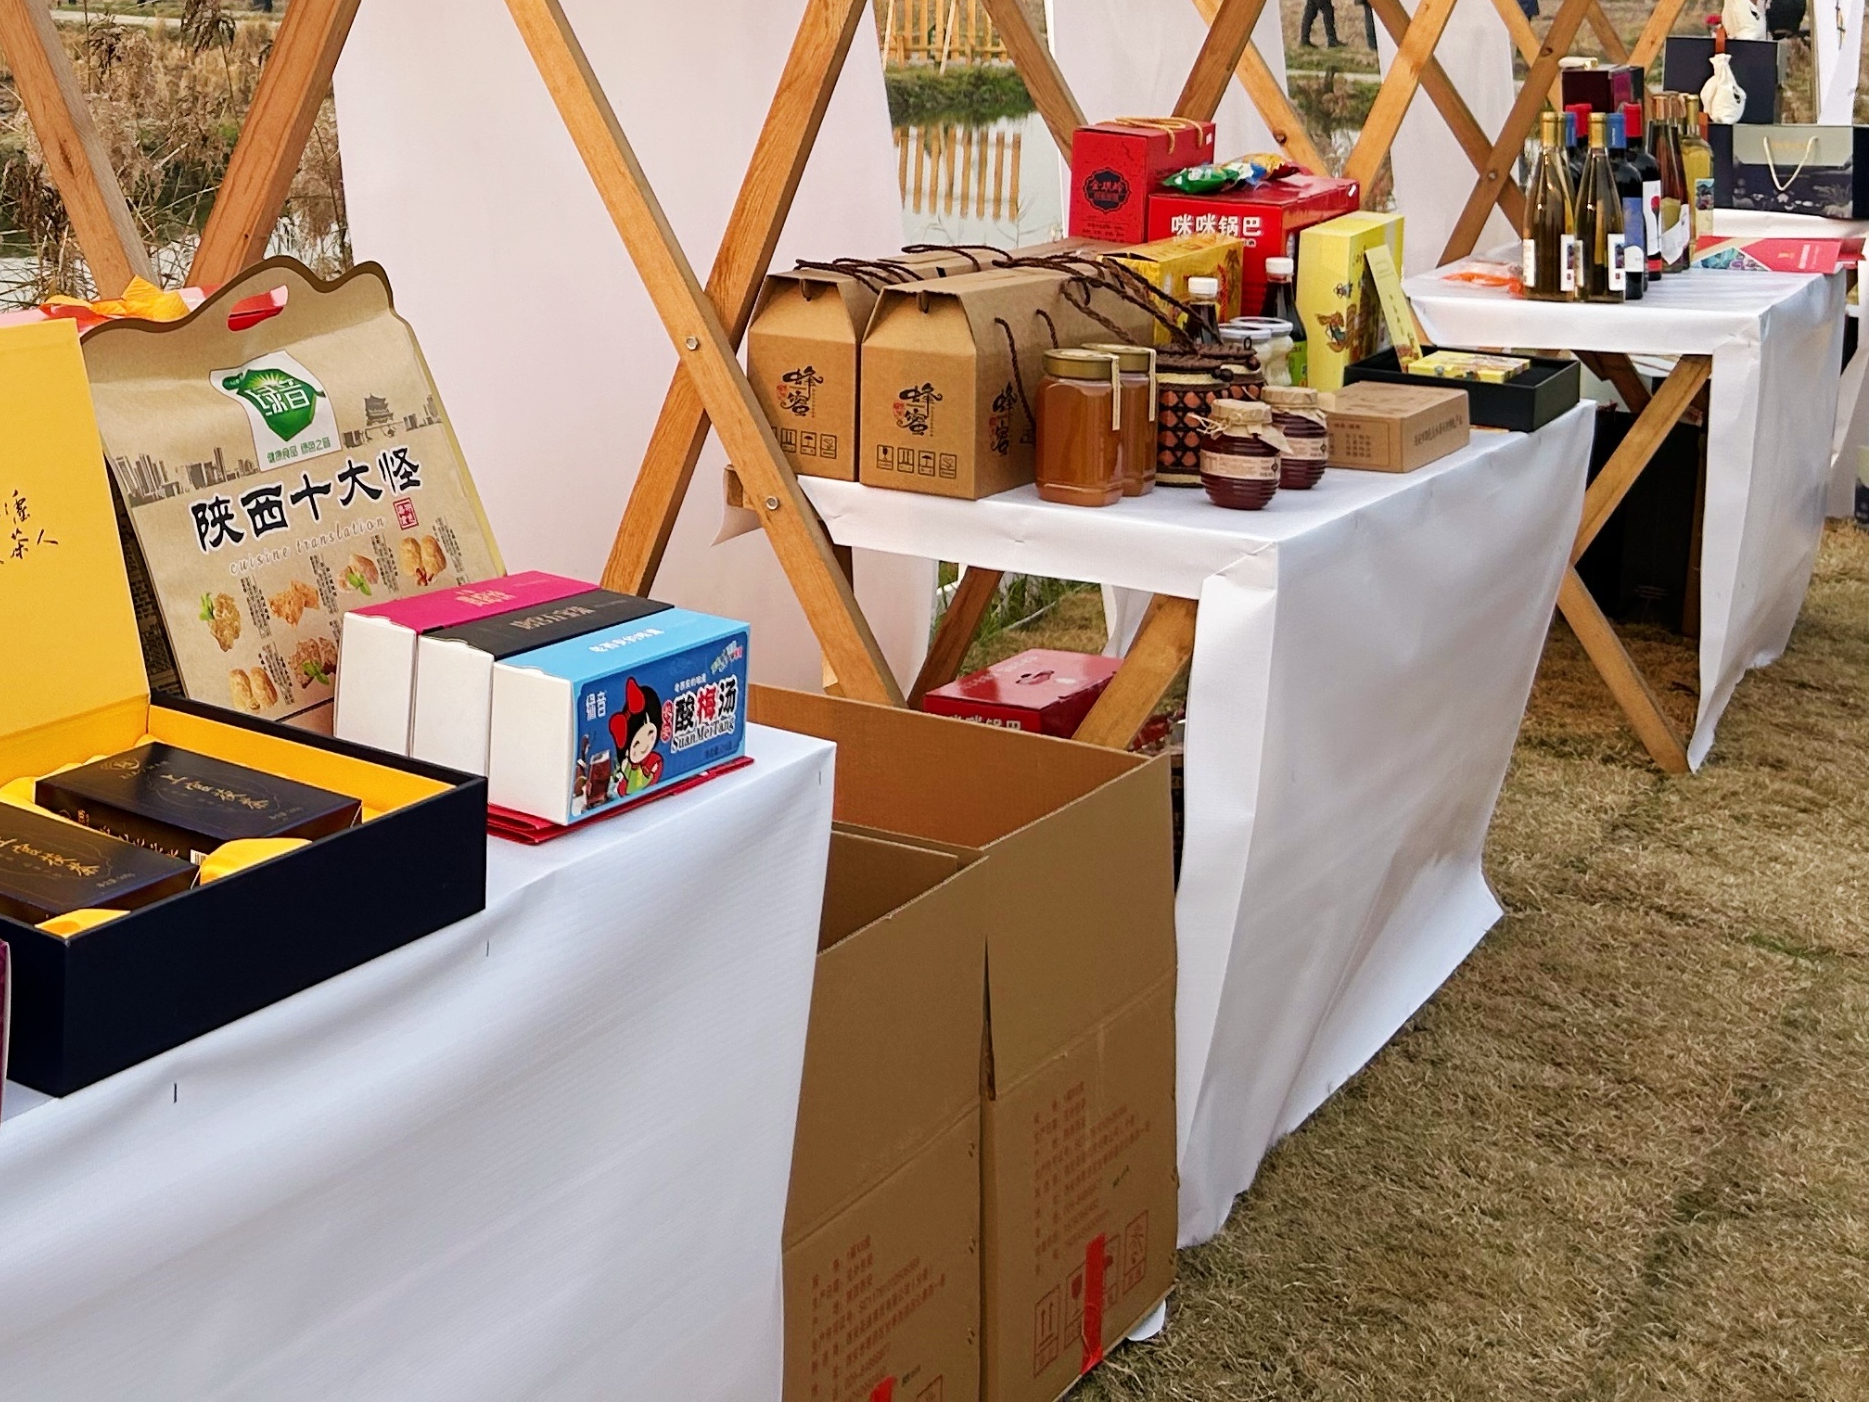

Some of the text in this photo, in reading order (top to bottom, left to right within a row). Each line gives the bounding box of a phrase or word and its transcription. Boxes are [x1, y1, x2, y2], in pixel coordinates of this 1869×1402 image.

[1171, 213, 1263, 237] 咪咪锅巴
[191, 448, 422, 551] 陕西十大怪
[229, 517, 386, 575] cuisine translation
[674, 674, 738, 734] 酸梅汤
